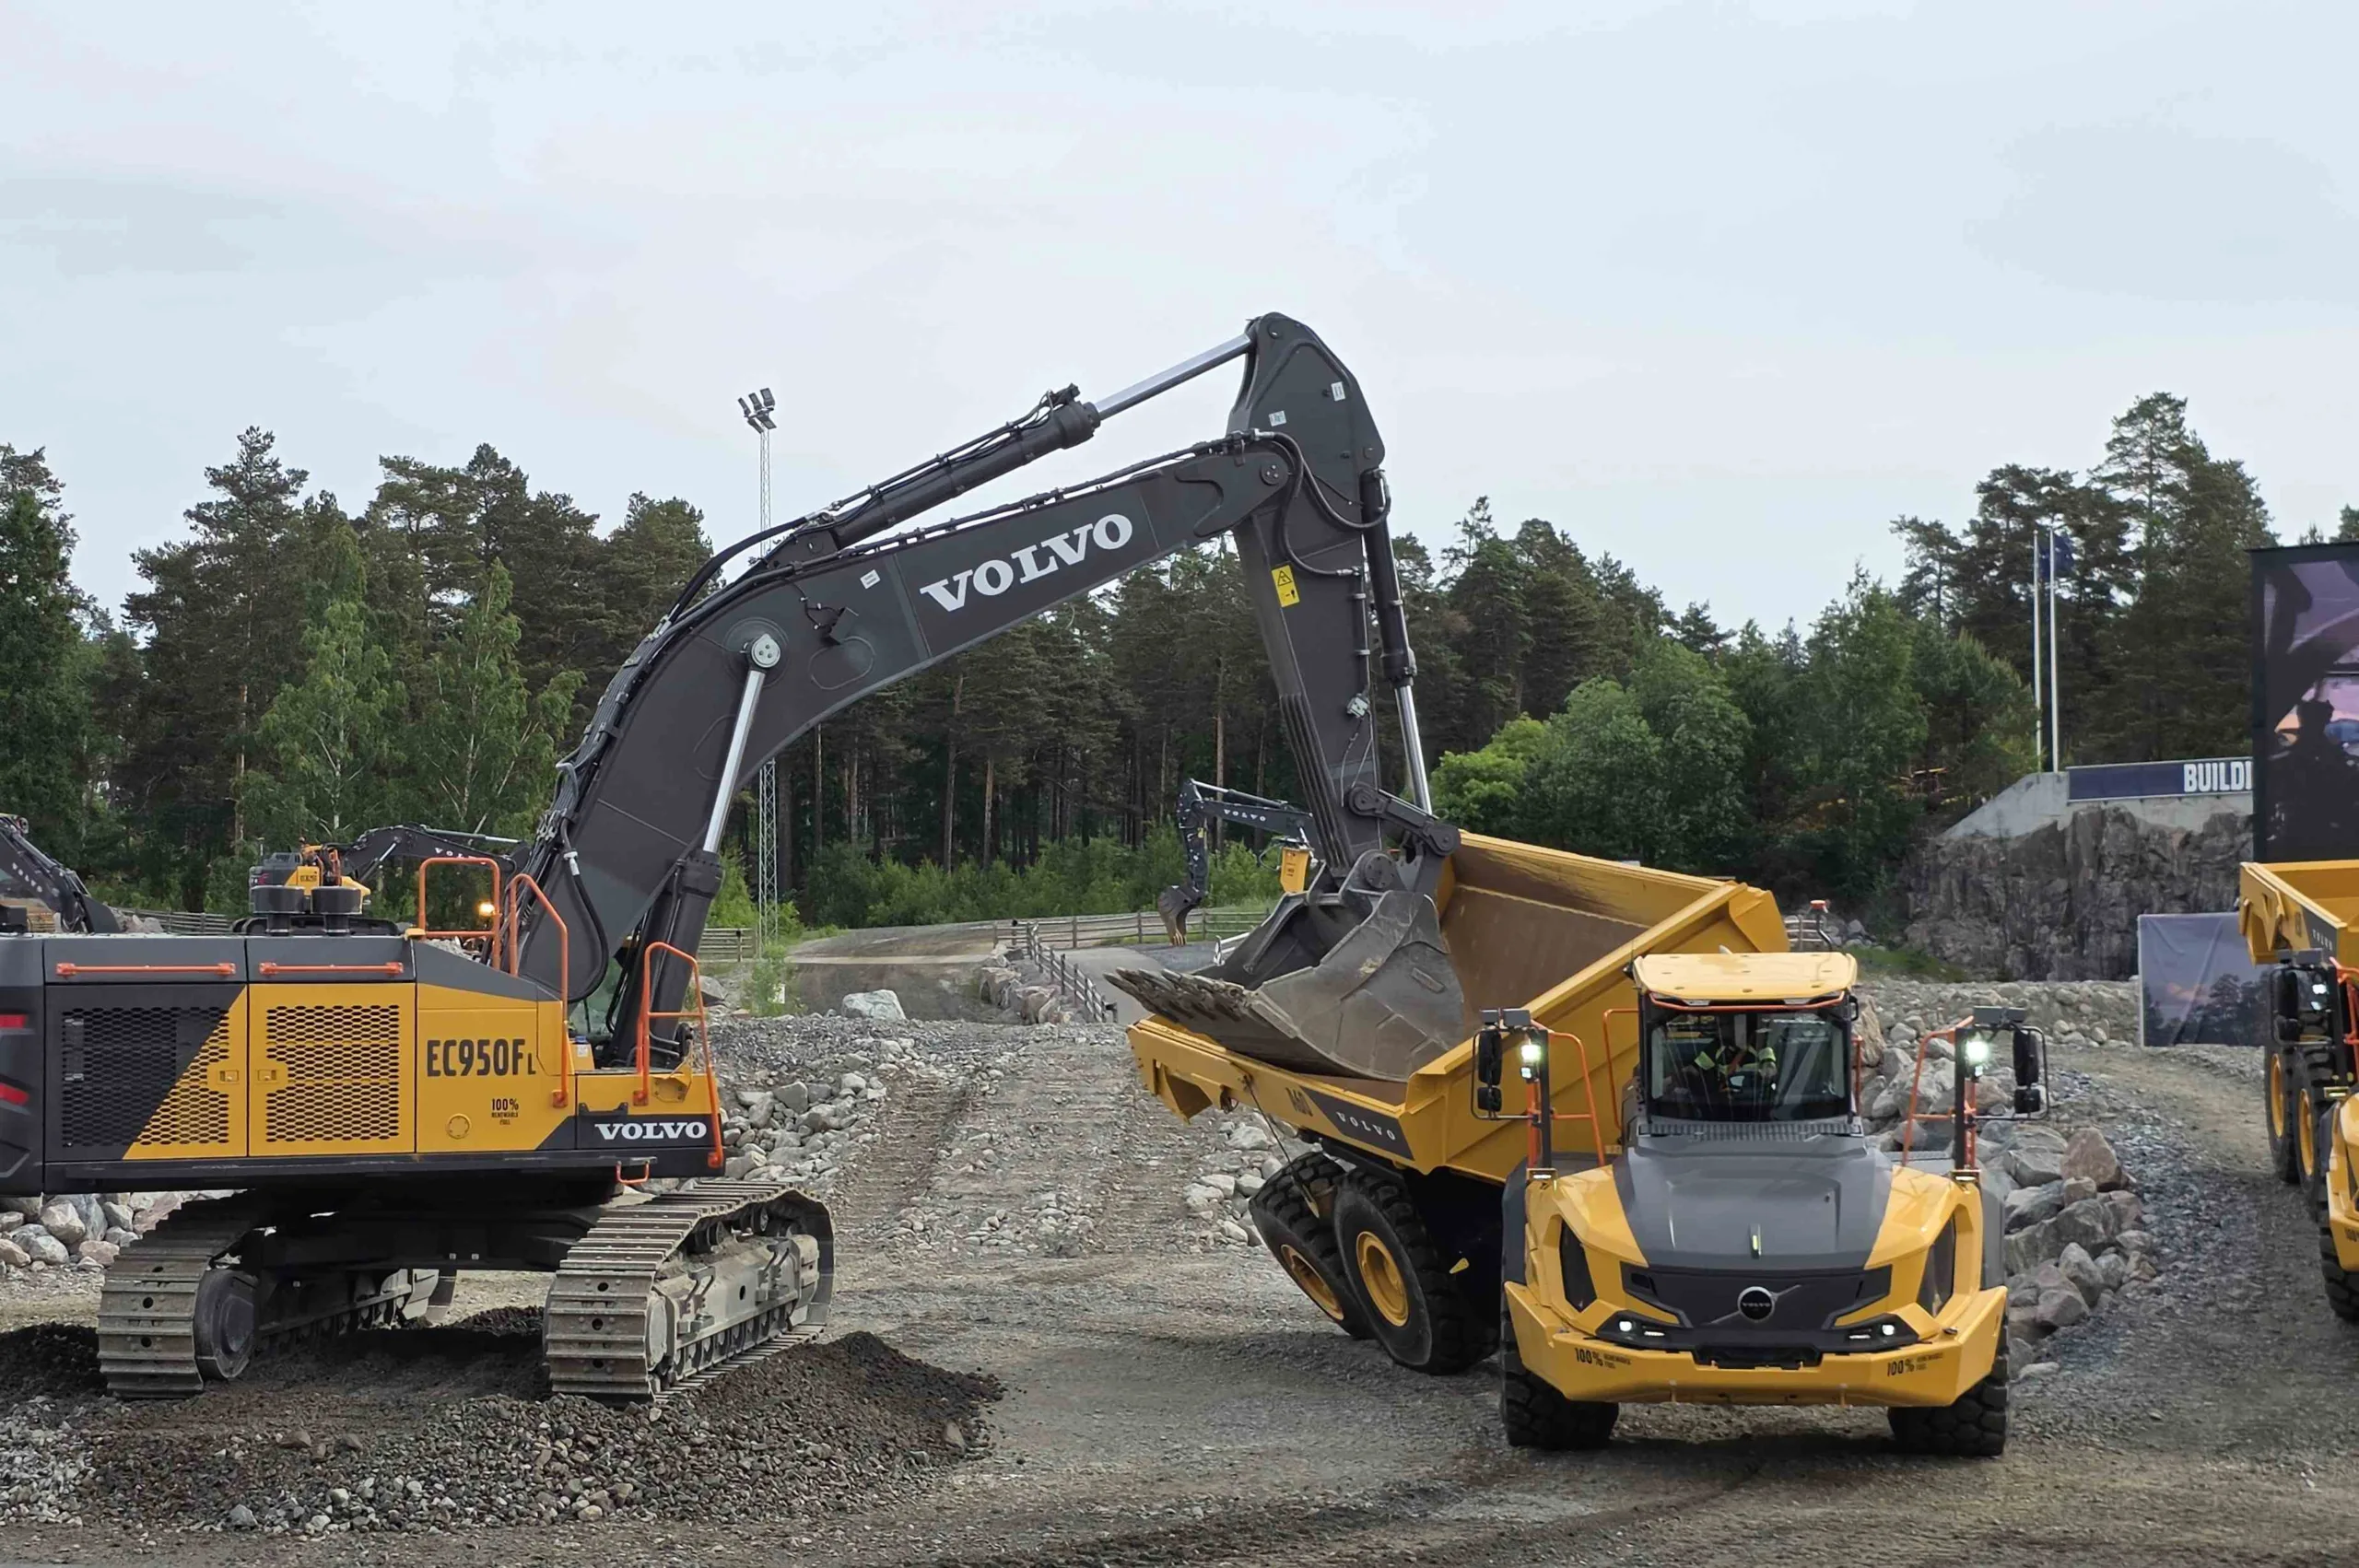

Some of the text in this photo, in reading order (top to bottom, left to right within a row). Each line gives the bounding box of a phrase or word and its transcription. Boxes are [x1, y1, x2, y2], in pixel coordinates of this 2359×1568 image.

[920, 514, 1133, 612] VOLVO
[1224, 809, 1266, 822] VOLVO
[435, 848, 487, 865] VOL
[491, 1098, 519, 1111] 100%
[594, 1121, 707, 1141] VOLVO
[1336, 1111, 1396, 1141] VOLVO
[1575, 1347, 1603, 1366] 100%
[1887, 1358, 1915, 1376] 100%
